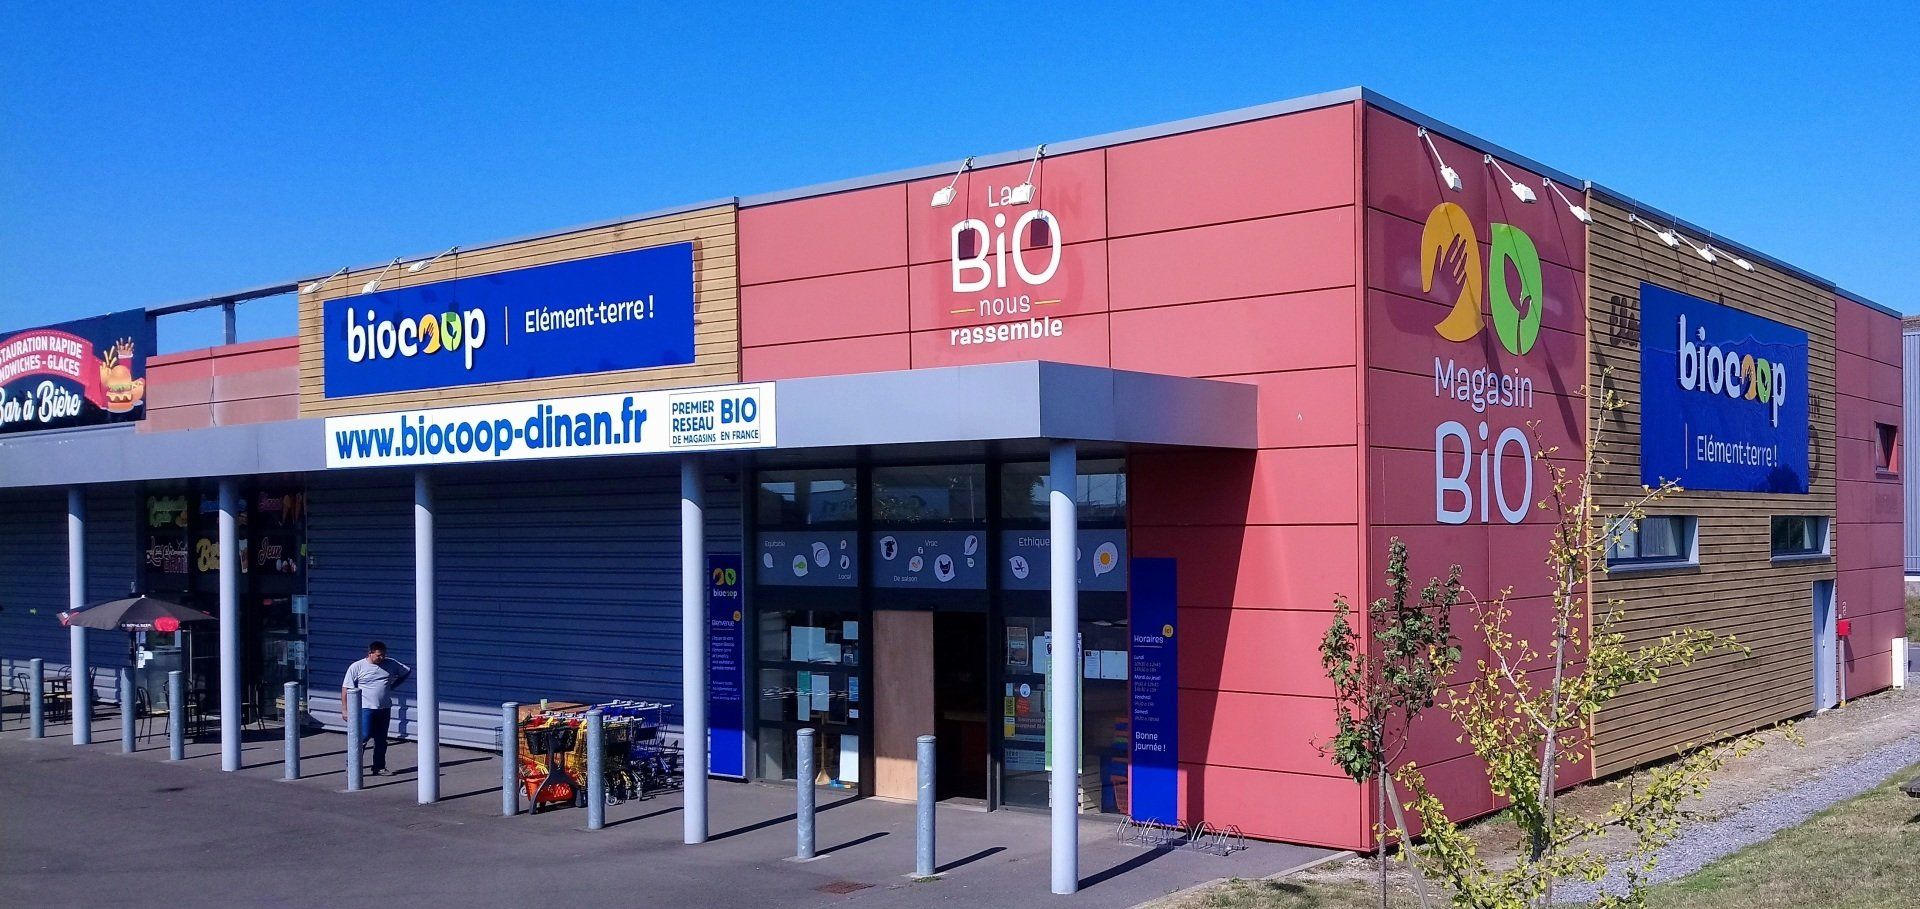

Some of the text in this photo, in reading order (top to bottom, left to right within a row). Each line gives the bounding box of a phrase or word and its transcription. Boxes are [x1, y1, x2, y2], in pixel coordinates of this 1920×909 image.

[988, 185, 1013, 208] La
[951, 209, 1062, 293] BiO
[525, 299, 645, 333] Elément-terre
[979, 294, 1031, 317] nous
[347, 306, 487, 370] biocoop
[950, 316, 1063, 346] rassemble
[49, 335, 83, 360] RAPIDE
[48, 354, 81, 377] GLACES
[1679, 313, 1786, 428] biocoop
[1434, 356, 1533, 413] Magasin
[23, 391, 35, 421] à
[37, 380, 81, 423] Bière
[672, 400, 715, 415] PREMIER
[720, 396, 757, 424] BIO
[335, 396, 648, 460] www.biocoop-dinan.fr
[672, 416, 714, 432] RESEAU
[720, 429, 759, 441] EN FRANCE
[672, 433, 717, 444] DE MAGASINS
[1696, 434, 1773, 466] Elément-terre
[1435, 420, 1534, 525] BiO
[924, 538, 938, 547] Vrac
[713, 588, 738, 599] biocoop
[1133, 634, 1164, 644] Horaires
[1134, 741, 1162, 752] journée
[1135, 731, 1158, 740] Bonne
